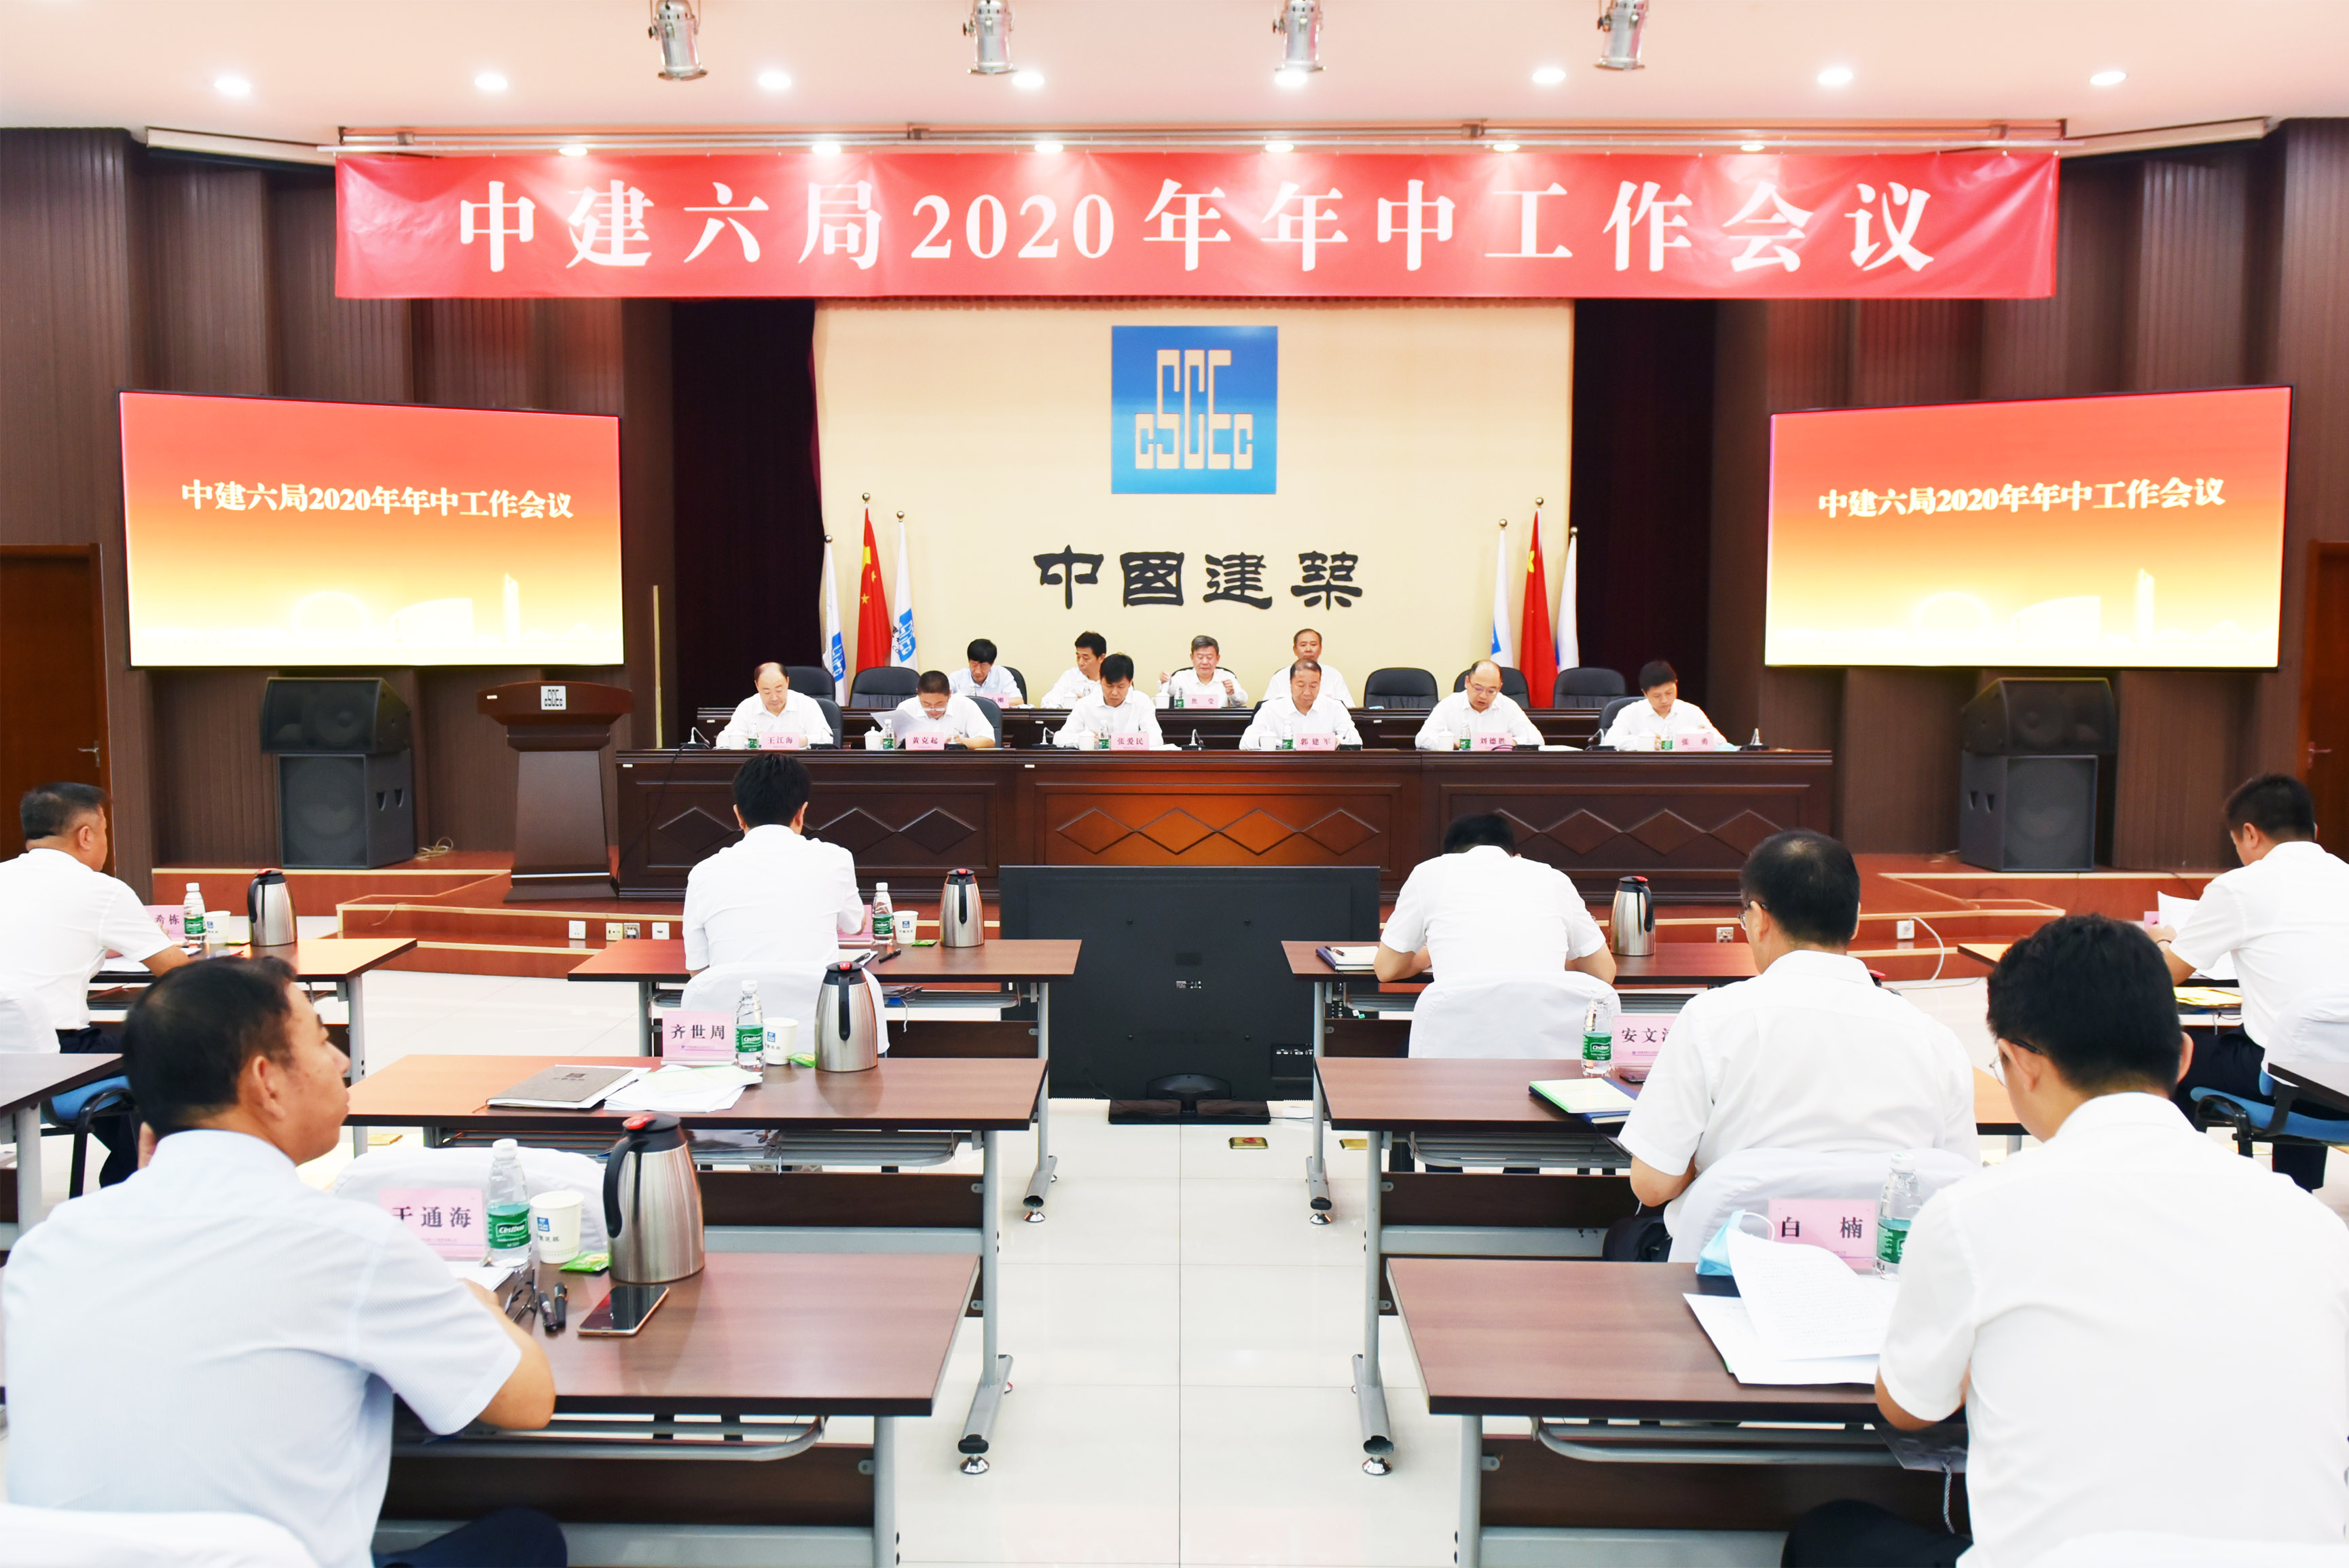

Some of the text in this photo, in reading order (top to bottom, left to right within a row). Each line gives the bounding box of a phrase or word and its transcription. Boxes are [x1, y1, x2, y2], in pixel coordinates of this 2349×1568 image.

[460, 179, 1935, 272] 中建六局2020年年中工作会议
[181, 478, 574, 519] 中建六局2020年年中工作会议
[1818, 477, 2226, 519] 中建六局2020年年中工作会议
[767, 736, 793, 745] 王江海
[912, 736, 939, 745] 黄克起
[1117, 737, 1144, 746] 张爱民
[670, 1023, 725, 1040] 齐世周
[1781, 1216, 1863, 1239] 白楠
